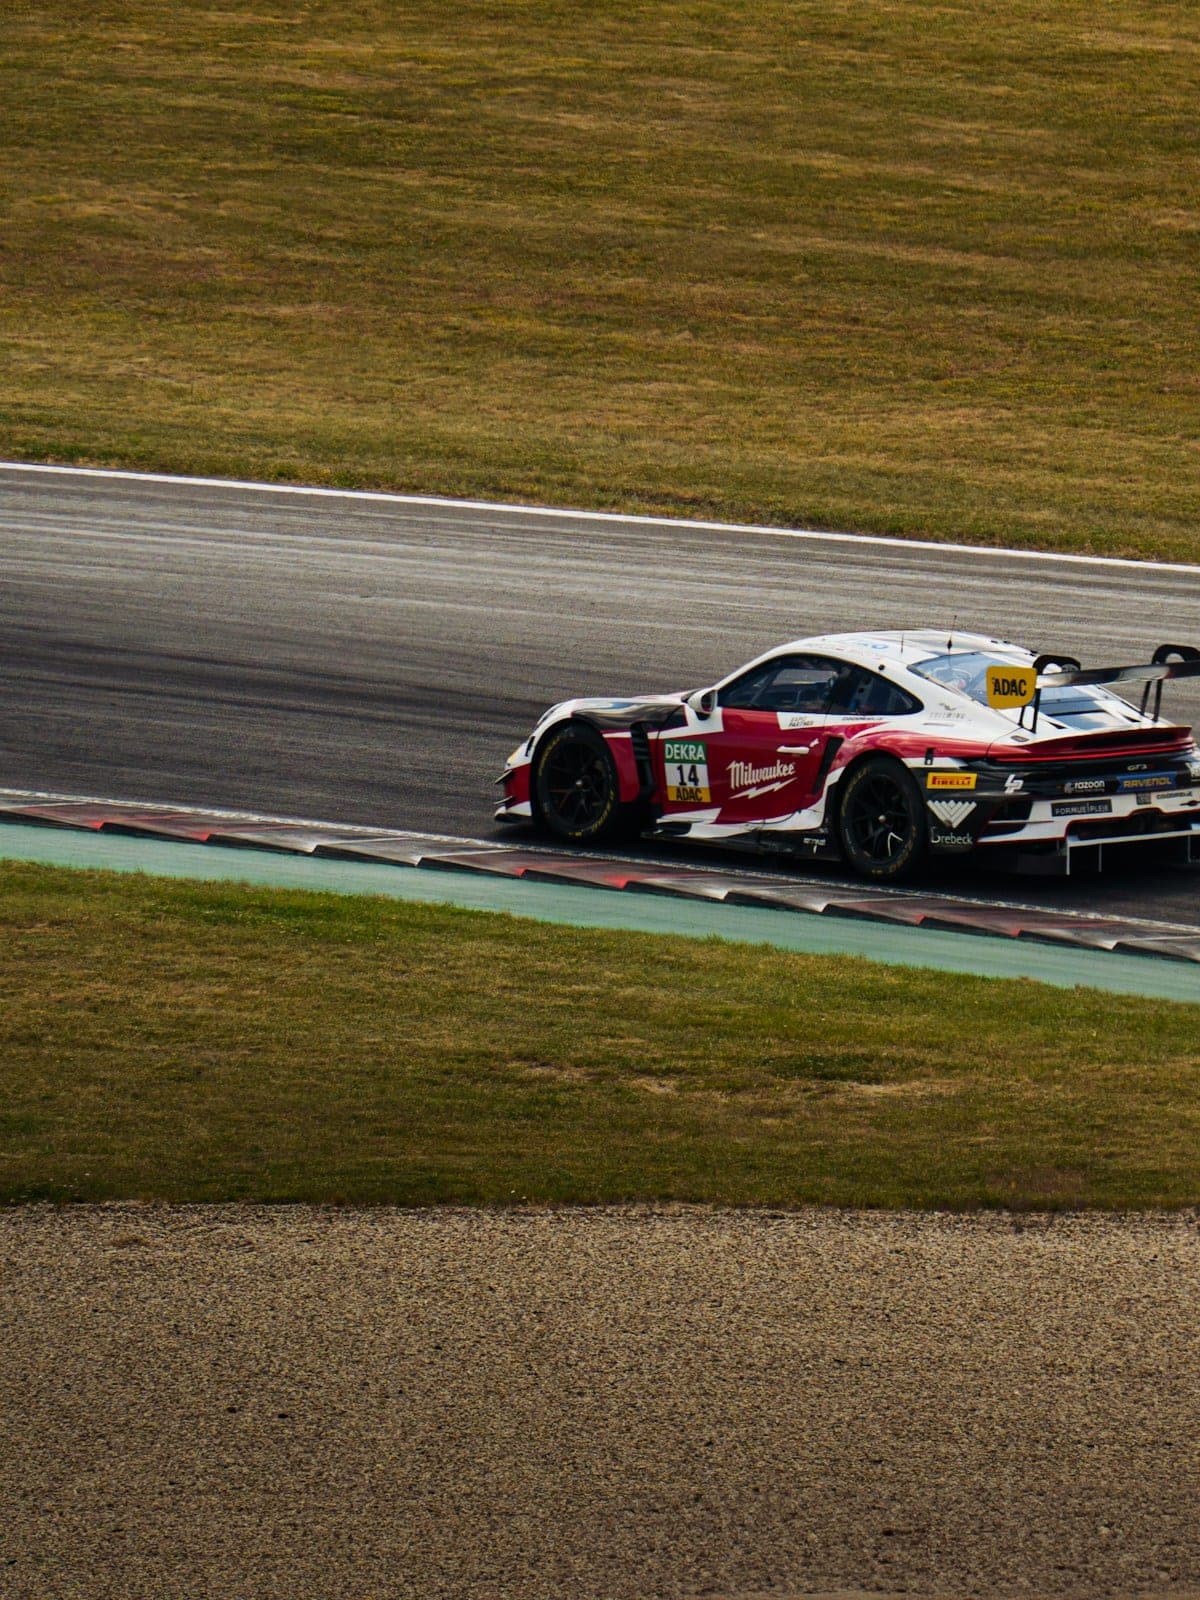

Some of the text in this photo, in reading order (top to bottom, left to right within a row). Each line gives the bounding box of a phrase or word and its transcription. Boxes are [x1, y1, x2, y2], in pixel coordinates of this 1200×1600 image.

[992, 678, 1027, 696] ADAC
[664, 743, 706, 761] DEKRA
[676, 764, 699, 786] 14
[726, 760, 796, 790] Milwaukee
[931, 775, 972, 786] PIRELLI
[1123, 777, 1172, 788] RAVENOL
[1074, 780, 1105, 790] razoon
[675, 787, 703, 800] ADAC
